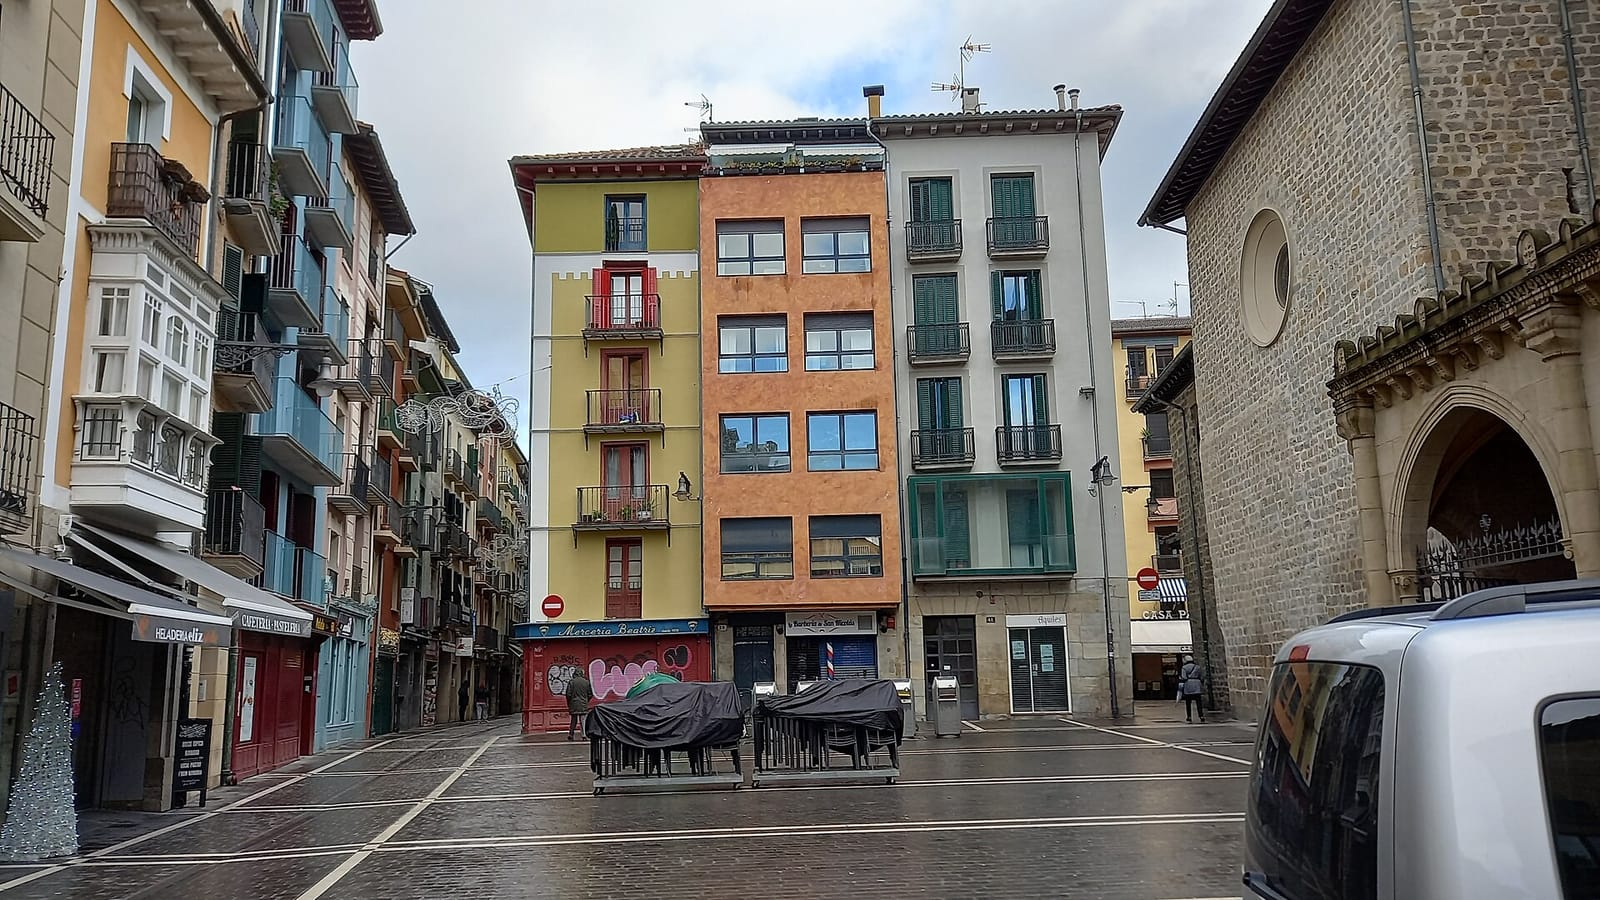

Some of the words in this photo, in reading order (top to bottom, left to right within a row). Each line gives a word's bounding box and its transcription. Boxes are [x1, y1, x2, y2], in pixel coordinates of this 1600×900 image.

[1142, 610, 1173, 620] CASA
[241, 614, 271, 630] CAFETERÍA
[614, 623, 656, 635] Beatriz
